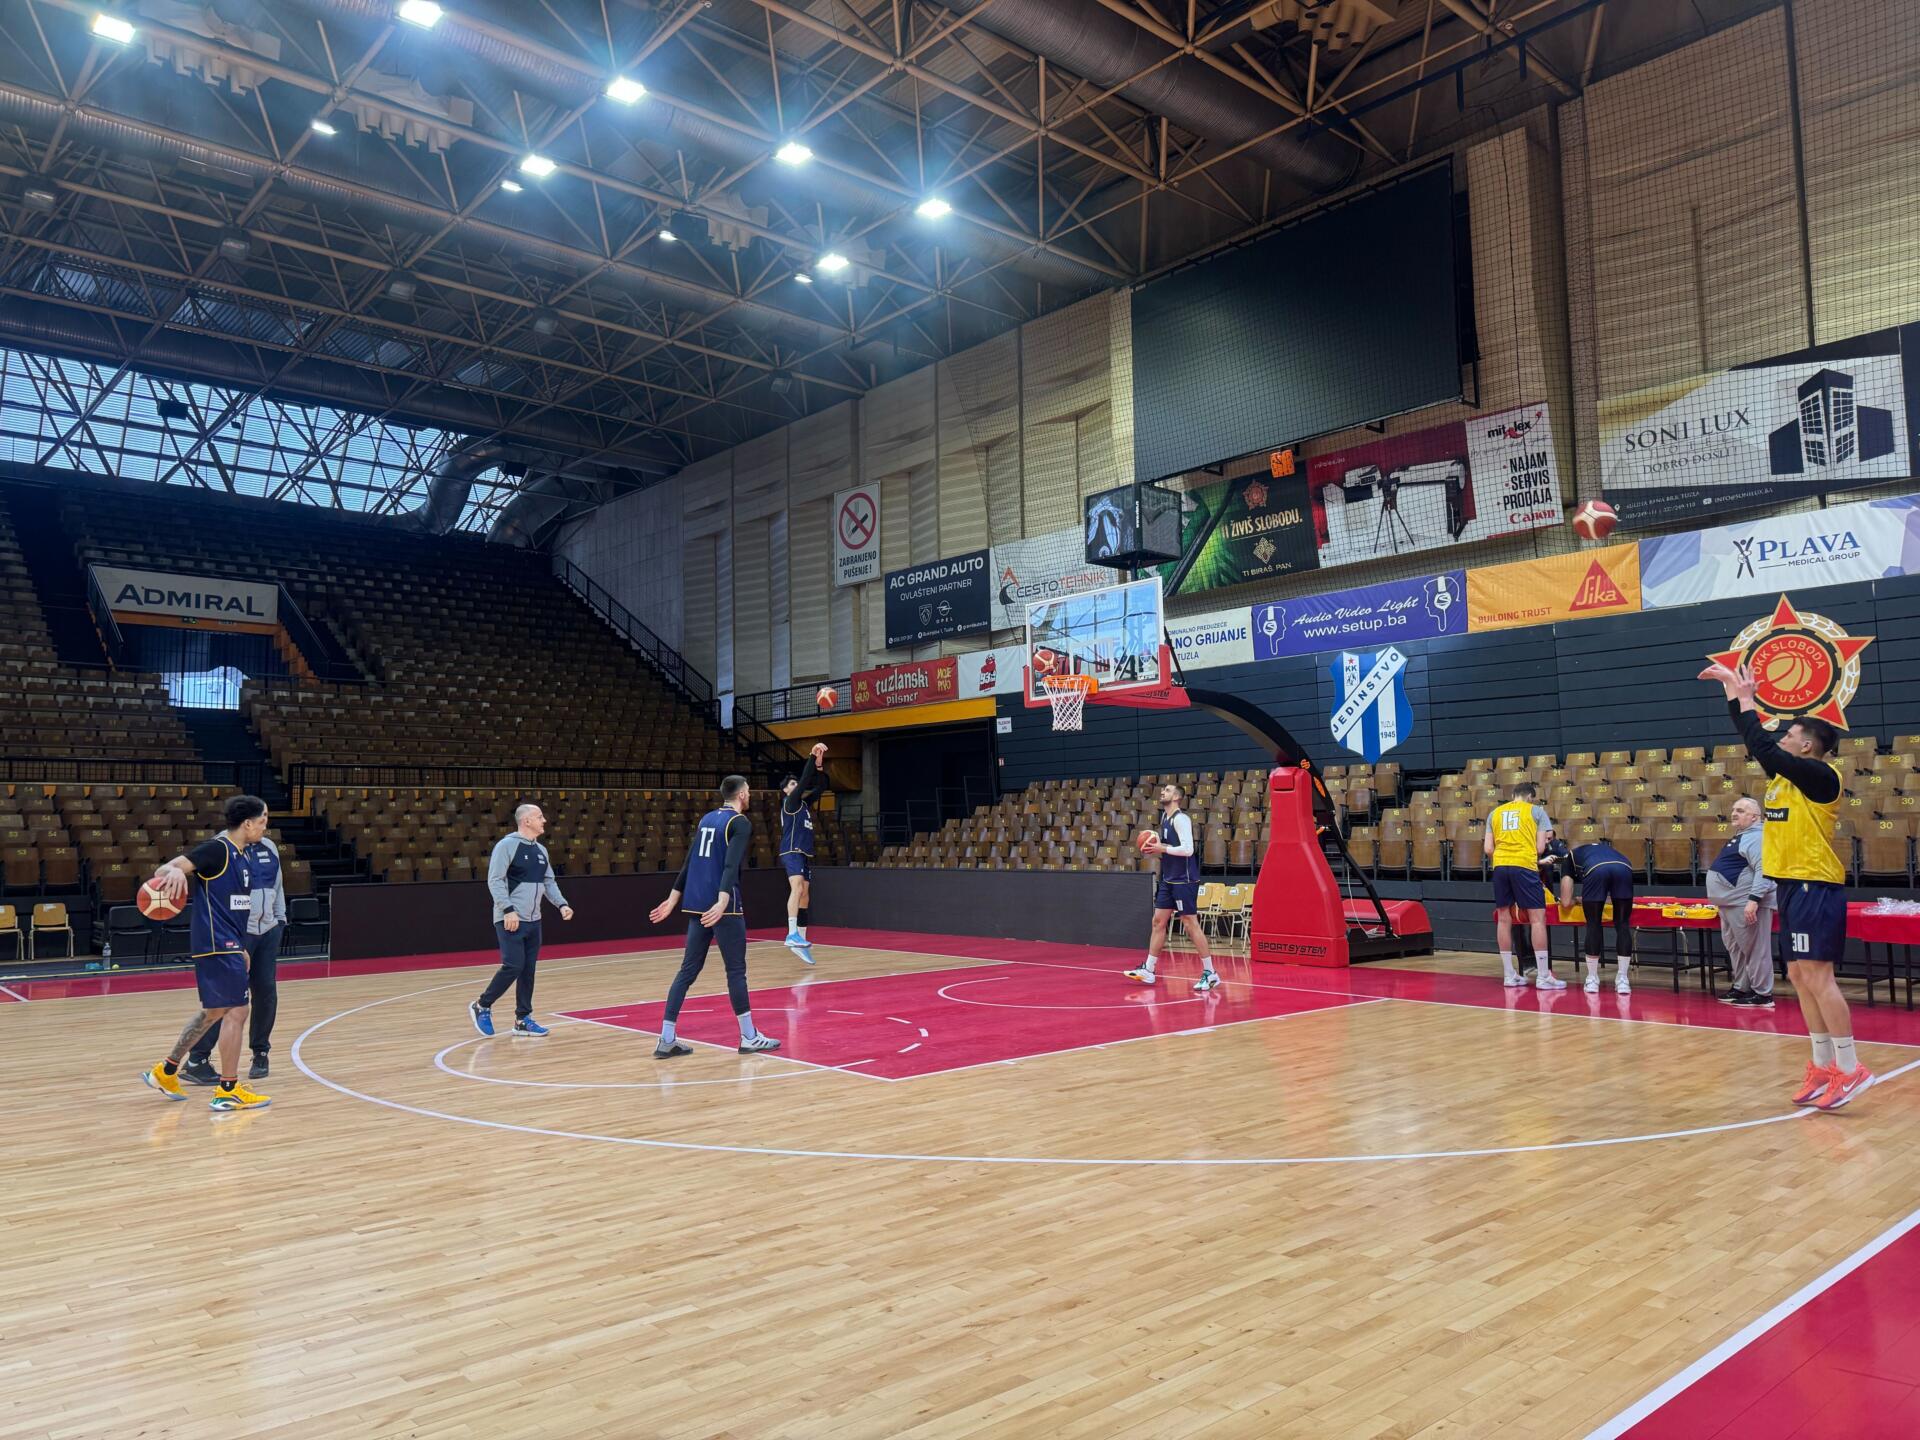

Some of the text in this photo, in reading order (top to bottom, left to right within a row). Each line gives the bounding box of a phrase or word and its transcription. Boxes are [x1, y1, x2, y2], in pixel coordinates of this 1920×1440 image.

[1625, 421, 1688, 452] SONI
[1700, 407, 1750, 436] LUX
[1509, 451, 1548, 473] NAJAM
[1643, 457, 1689, 474] DOBRO
[1511, 470, 1550, 491] SERVIS
[1503, 488, 1552, 511] PRODAJA
[1230, 515, 1254, 537] ŽIVIŠ
[1255, 508, 1303, 534] SLOBODU.
[1509, 509, 1555, 524] Canon
[1756, 531, 1861, 562] PLAVA
[838, 550, 877, 567] ZABRANJENO
[1788, 551, 1861, 567] MEDICAL GROUP
[843, 565, 868, 578] PUŠENJE
[889, 557, 984, 590] AC GRAND AUTO
[900, 578, 972, 601] OVLAŠTENI PARTNER
[1576, 575, 1617, 606] Sika
[115, 584, 265, 617] ADMIRAL
[1291, 597, 1420, 627] Audio Video Light
[1478, 607, 1553, 624] BUILDING TRUST
[1168, 626, 1196, 636] OMUNALNO
[1195, 627, 1247, 646] GRIJANJE
[1303, 614, 1407, 638] www.setup.ba
[1177, 651, 1200, 661] TUZLA
[1754, 640, 1826, 675] OKK SLOBODA
[875, 667, 929, 696] tuzlanski
[886, 691, 919, 706] pilsner
[1332, 652, 1399, 733] JEDINSTVO
[1772, 689, 1814, 703] TUZLA
[1380, 730, 1396, 739] 1945
[1502, 811, 1520, 831] 15
[699, 827, 715, 858] 17
[1258, 941, 1327, 955] SPORTSYSTEM
[1792, 933, 1810, 953] 30
